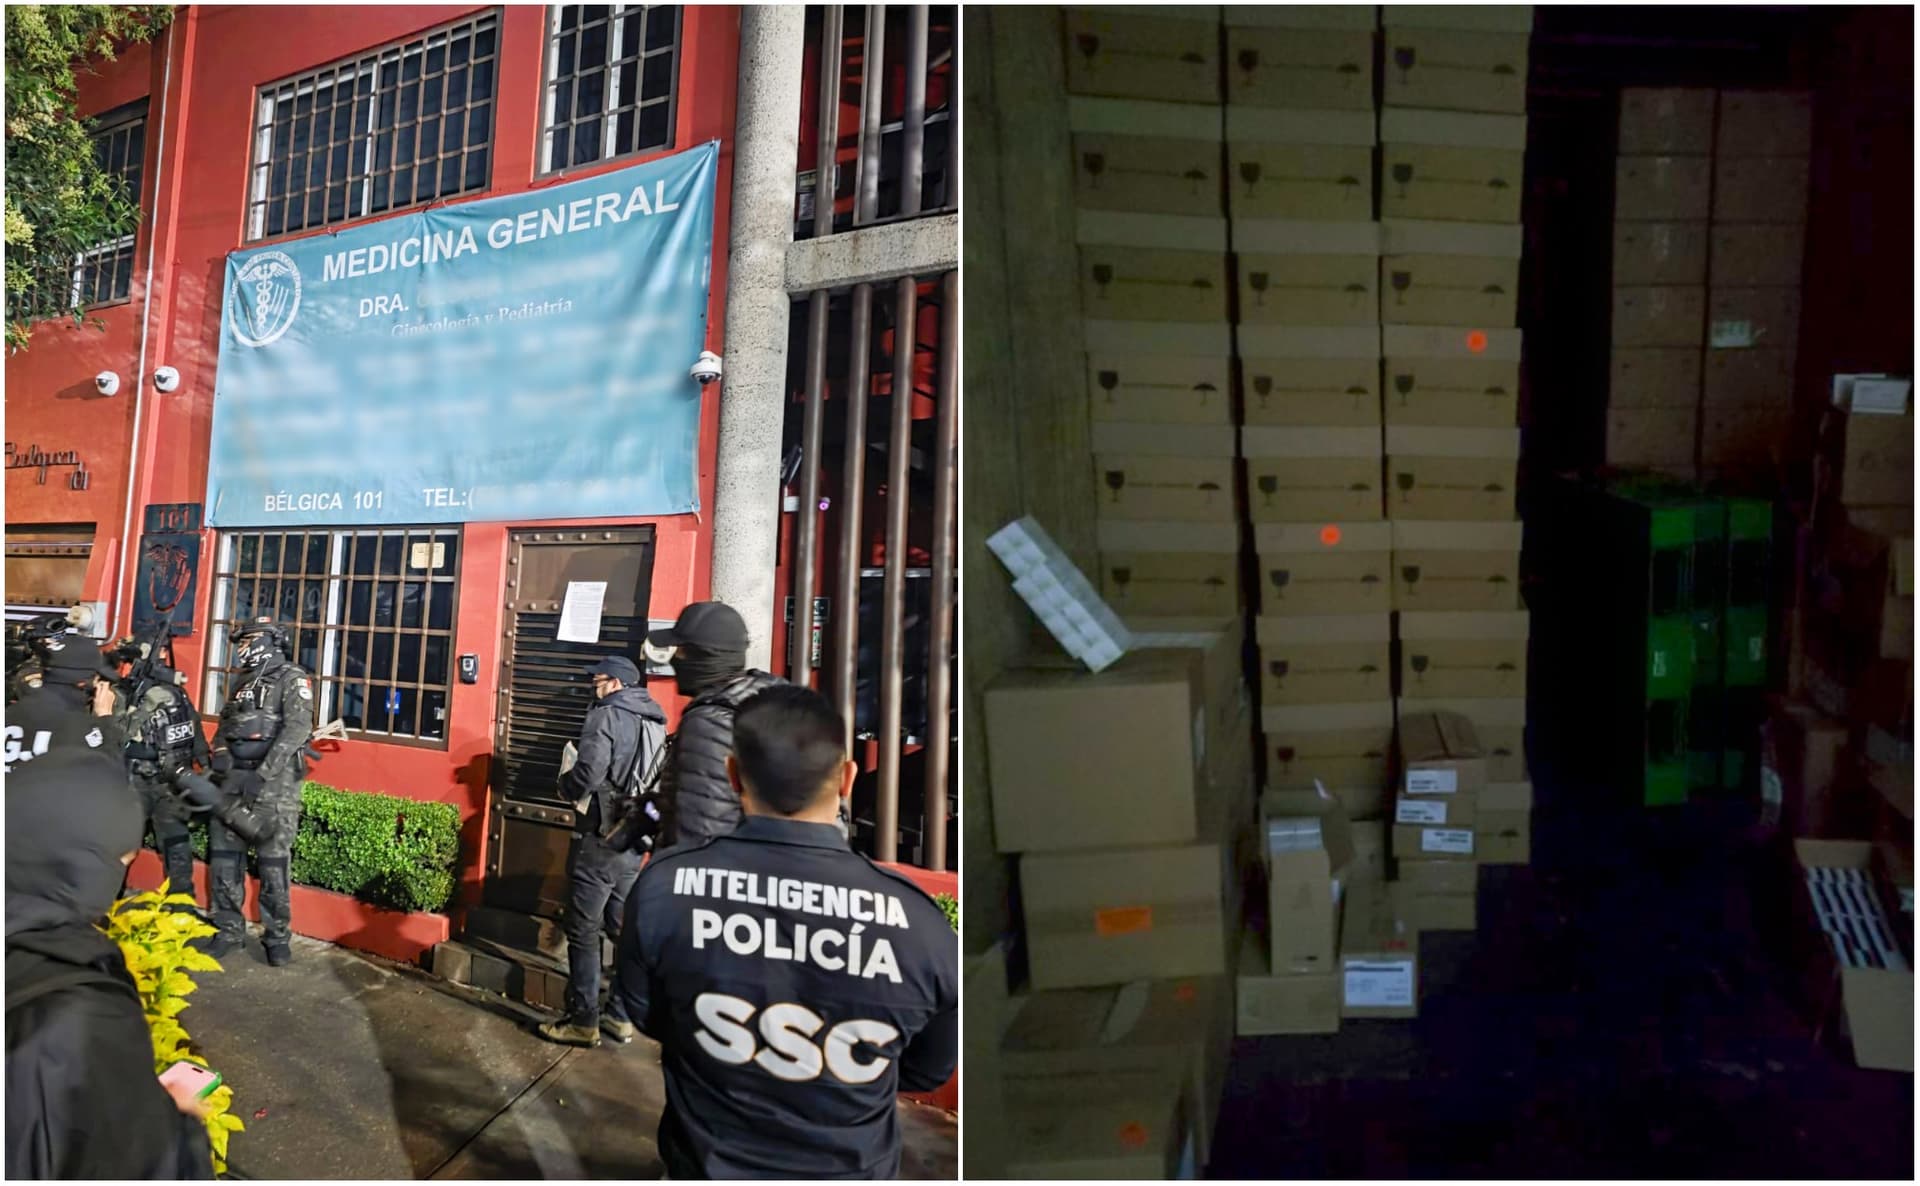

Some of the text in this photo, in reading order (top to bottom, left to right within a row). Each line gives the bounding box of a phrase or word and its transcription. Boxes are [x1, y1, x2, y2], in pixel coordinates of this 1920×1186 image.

[323, 225, 479, 282] MEDICINA
[487, 179, 680, 250] GENERAL
[359, 293, 409, 318] DRA.
[498, 297, 573, 322] Pediatría
[158, 506, 190, 529] 101
[264, 490, 343, 512] BÉLGICA
[353, 491, 383, 510] 101
[673, 867, 909, 929] INTELIGENCIA
[692, 908, 903, 983] POLICÍA
[694, 993, 899, 1083] SSC
